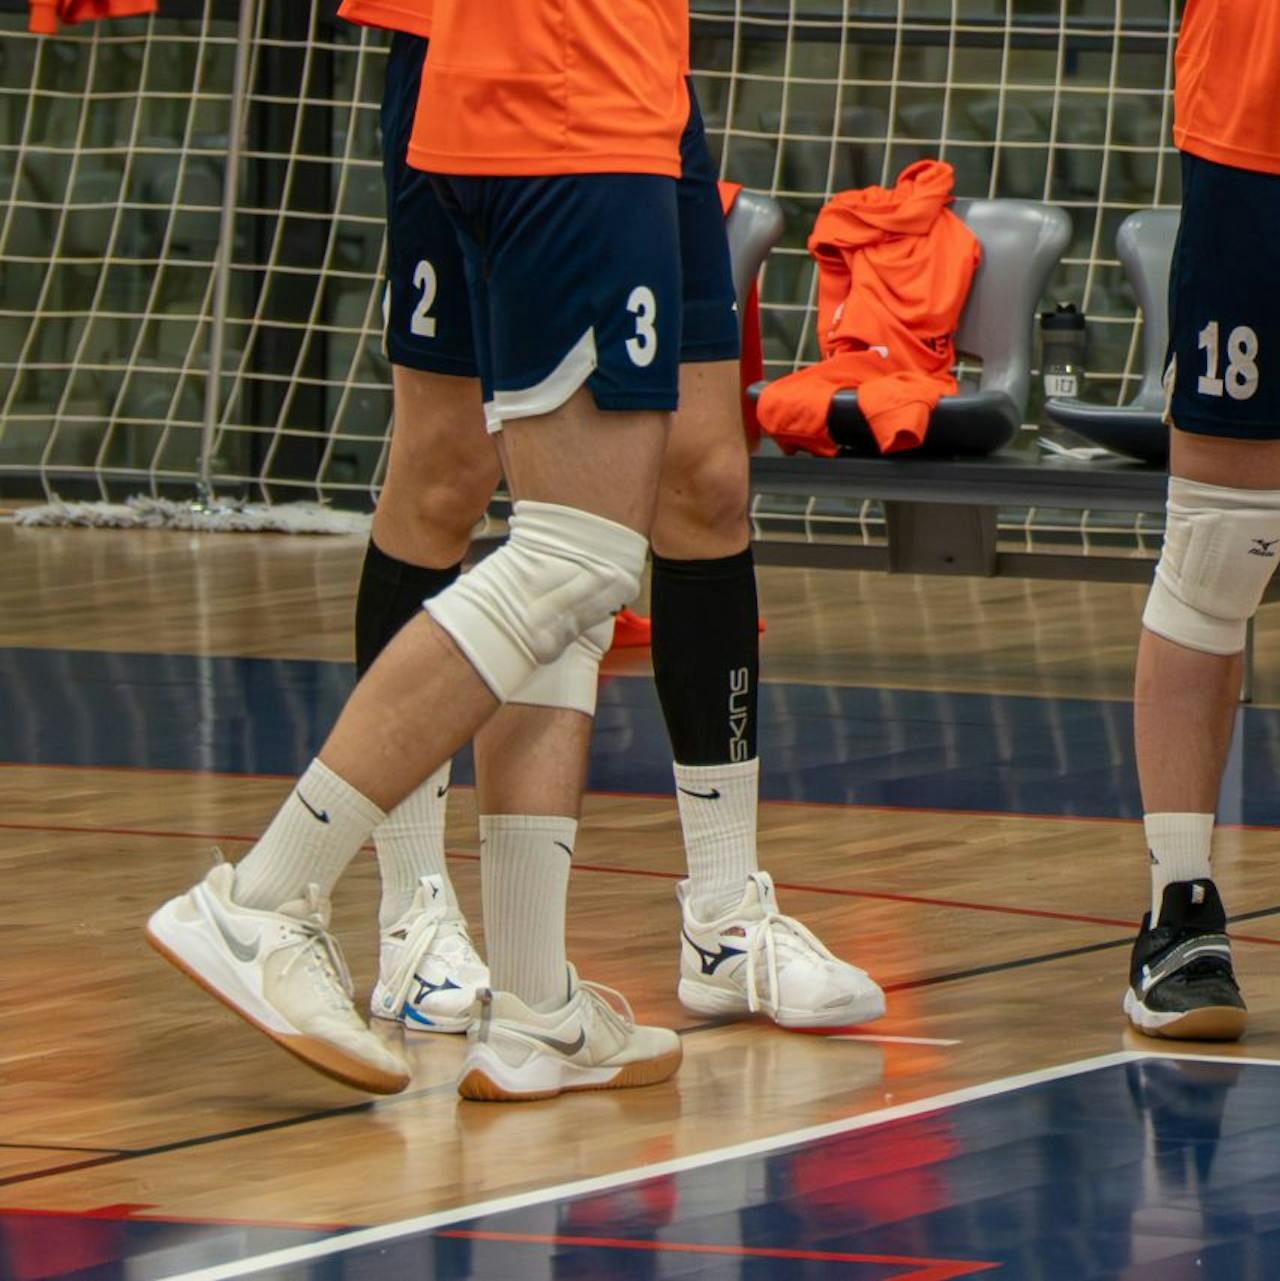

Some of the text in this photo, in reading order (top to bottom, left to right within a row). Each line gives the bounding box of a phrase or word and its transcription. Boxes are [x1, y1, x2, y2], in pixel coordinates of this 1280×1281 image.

[410, 260, 437, 338] 2
[625, 285, 657, 367] 3
[1197, 321, 1259, 400] 18
